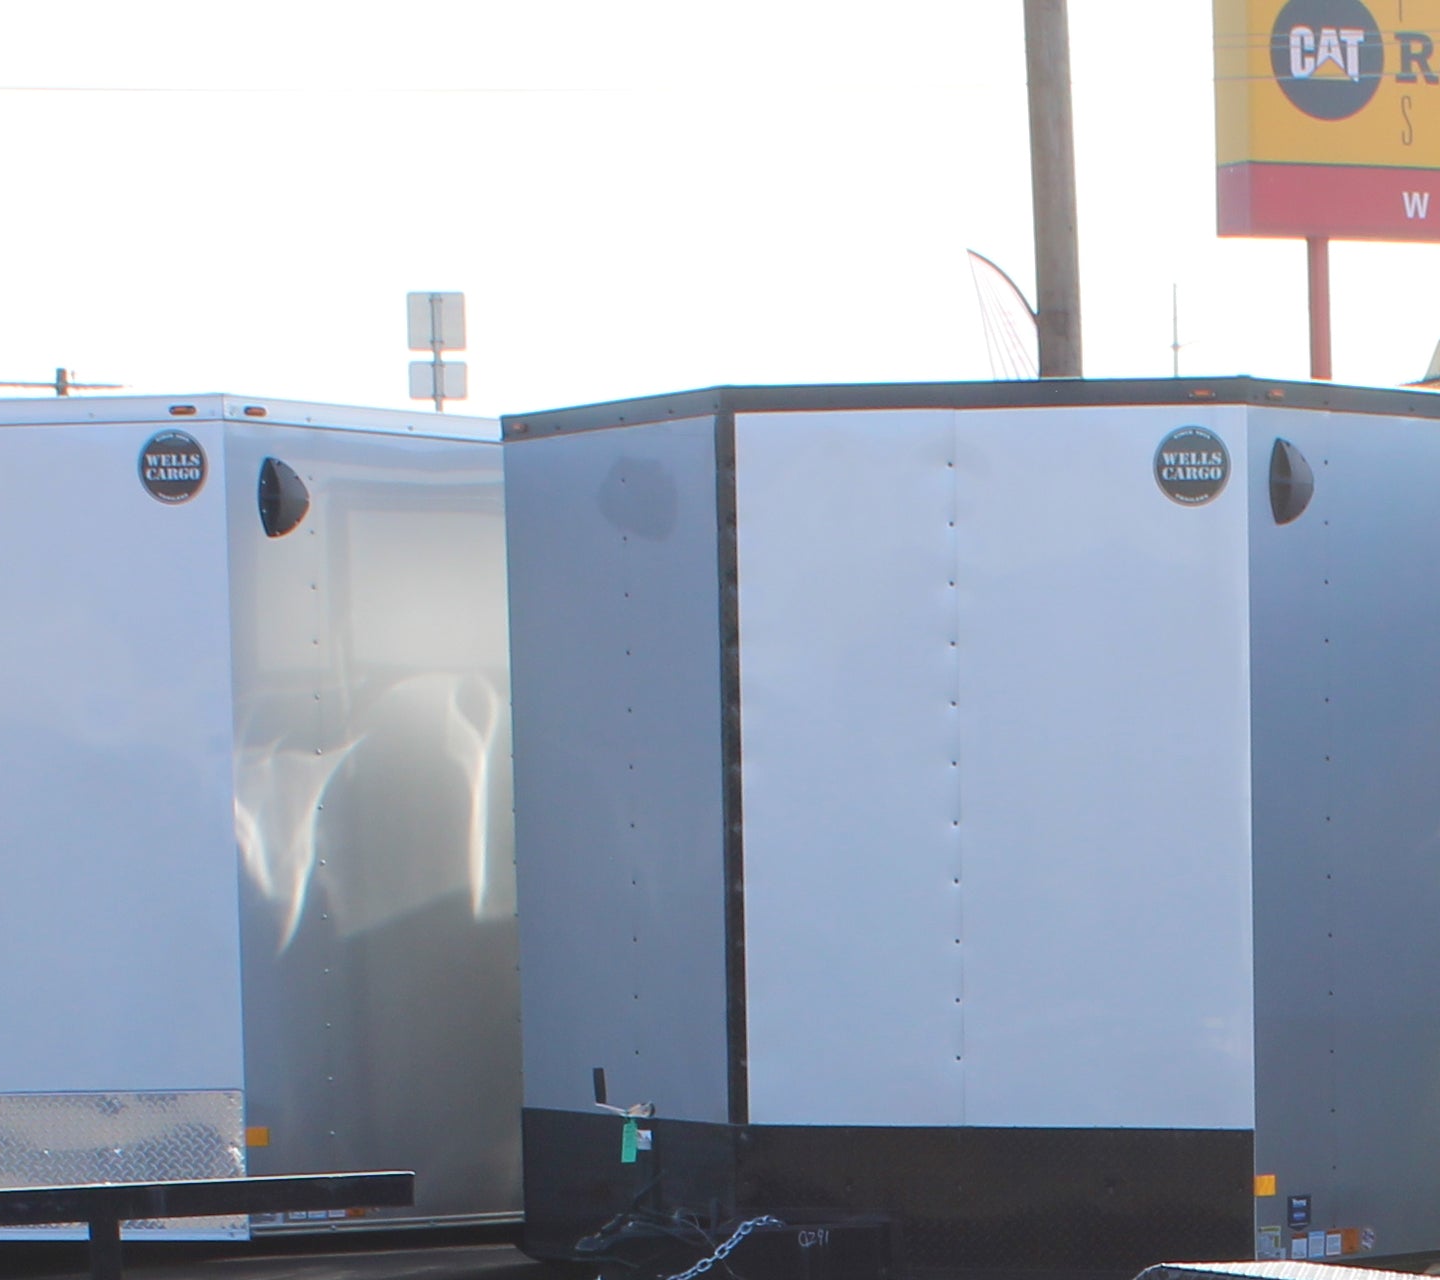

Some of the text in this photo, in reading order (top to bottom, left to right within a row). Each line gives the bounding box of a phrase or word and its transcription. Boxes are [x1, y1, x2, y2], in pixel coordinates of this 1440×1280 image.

[1289, 26, 1364, 82] CAT
[145, 453, 200, 467] WELLS
[1162, 451, 1222, 466] WELLS
[145, 466, 200, 481] CARGO
[1162, 466, 1222, 481] CARGO
